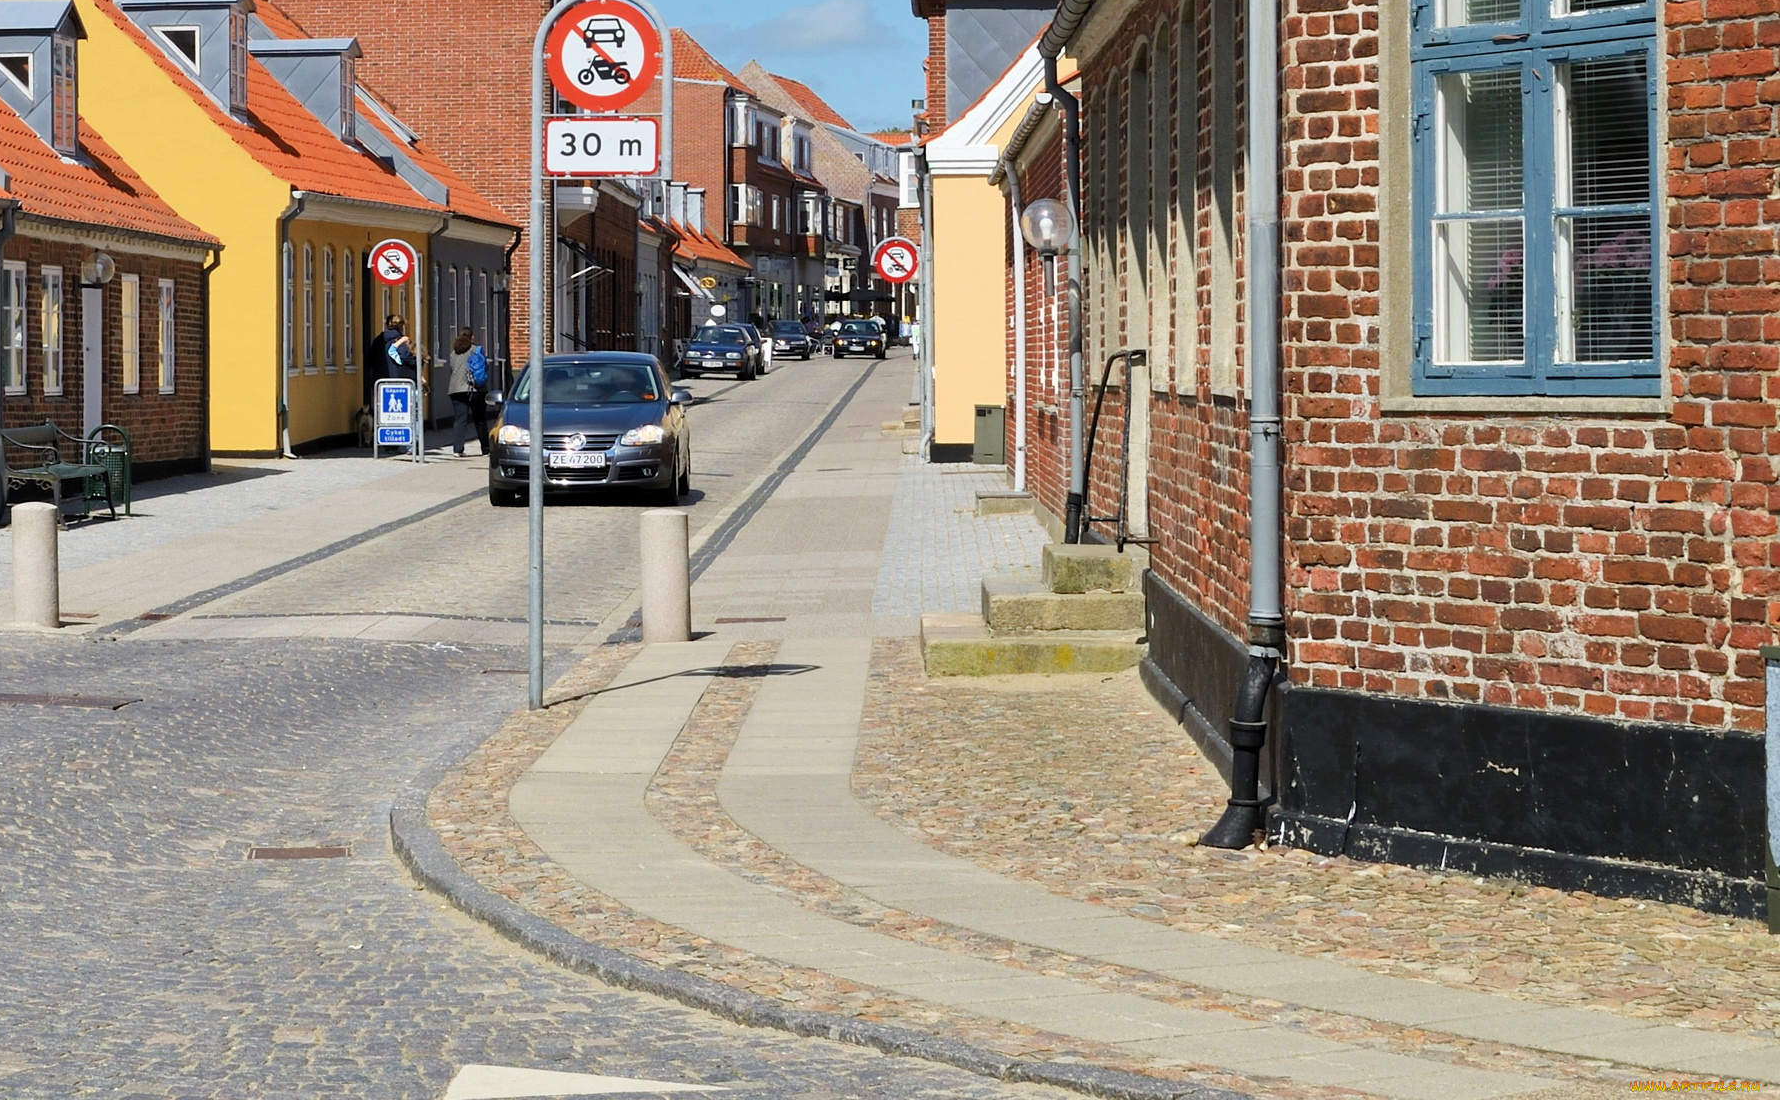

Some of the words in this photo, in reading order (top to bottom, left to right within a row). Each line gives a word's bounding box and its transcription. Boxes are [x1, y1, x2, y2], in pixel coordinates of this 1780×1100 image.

[560, 132, 601, 156] 30
[619, 138, 642, 156] m
[385, 429, 405, 437] Cykel
[552, 455, 567, 464] ZE
[583, 455, 603, 464] 200
